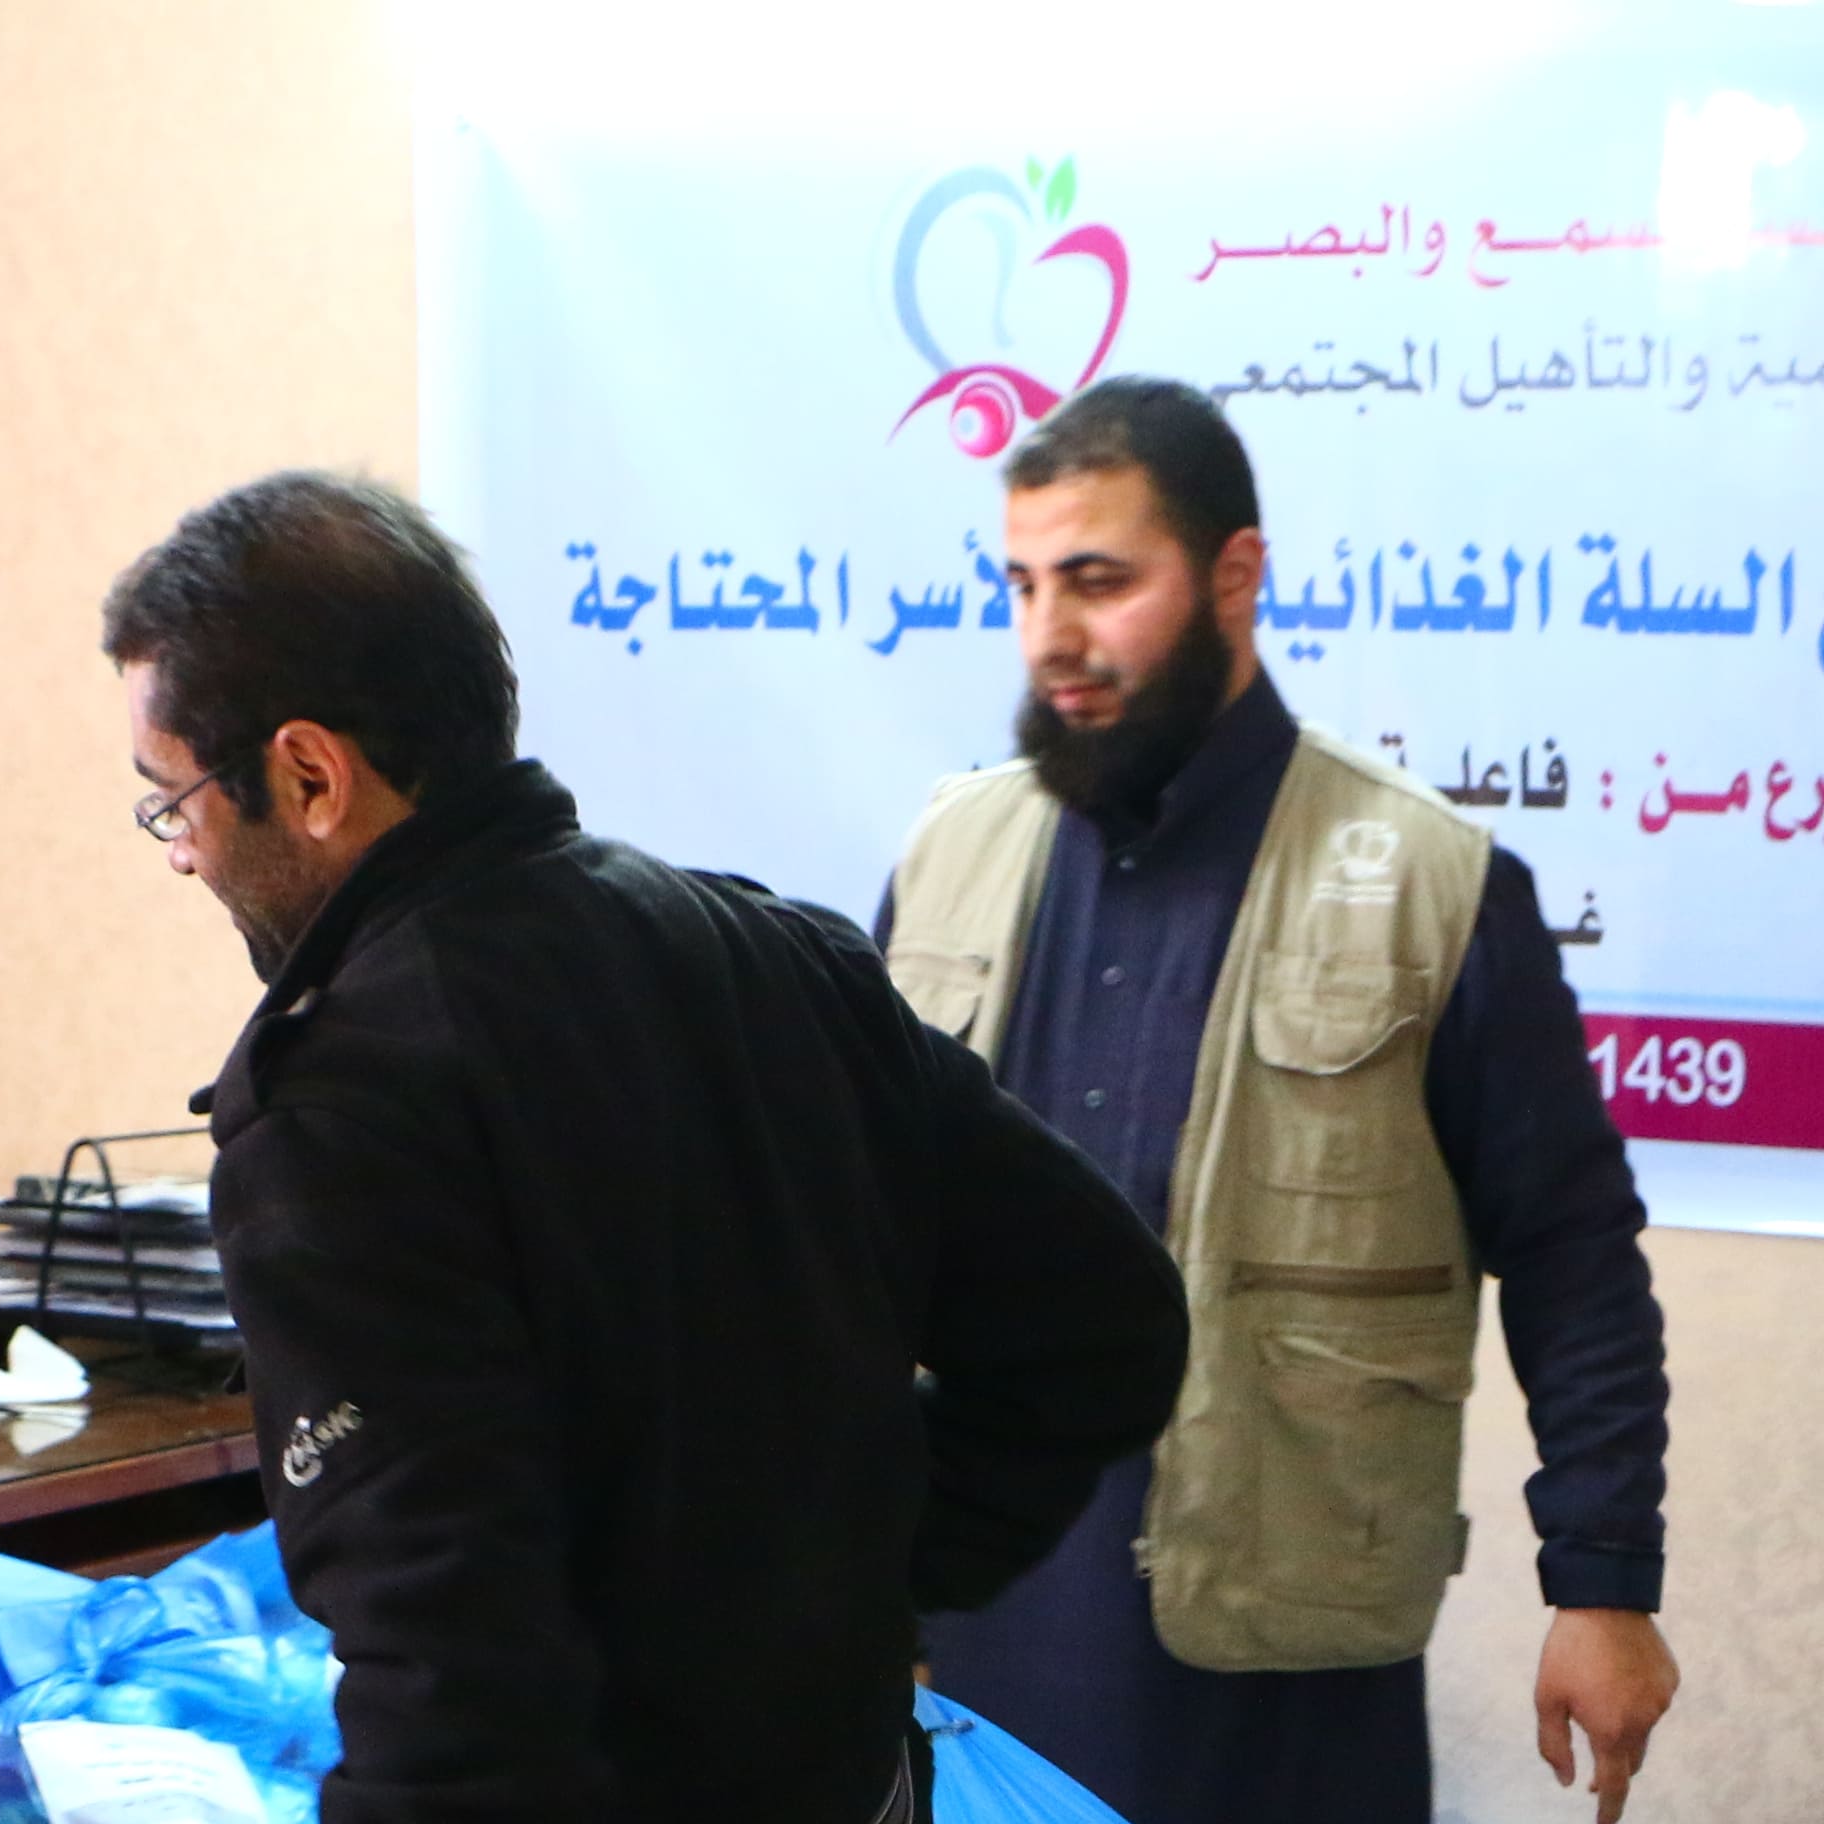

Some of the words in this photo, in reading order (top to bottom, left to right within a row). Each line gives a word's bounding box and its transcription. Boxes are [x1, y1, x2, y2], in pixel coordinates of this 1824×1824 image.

[1191, 201, 1446, 282] والبصر
[1460, 320, 1711, 412] والتأهيل
[565, 540, 849, 656] المحتاجة
[863, 528, 1012, 656] لأسر
[1576, 533, 1794, 636] السلة
[1636, 753, 1750, 835] من
[1588, 1033, 1747, 1108] 1439
